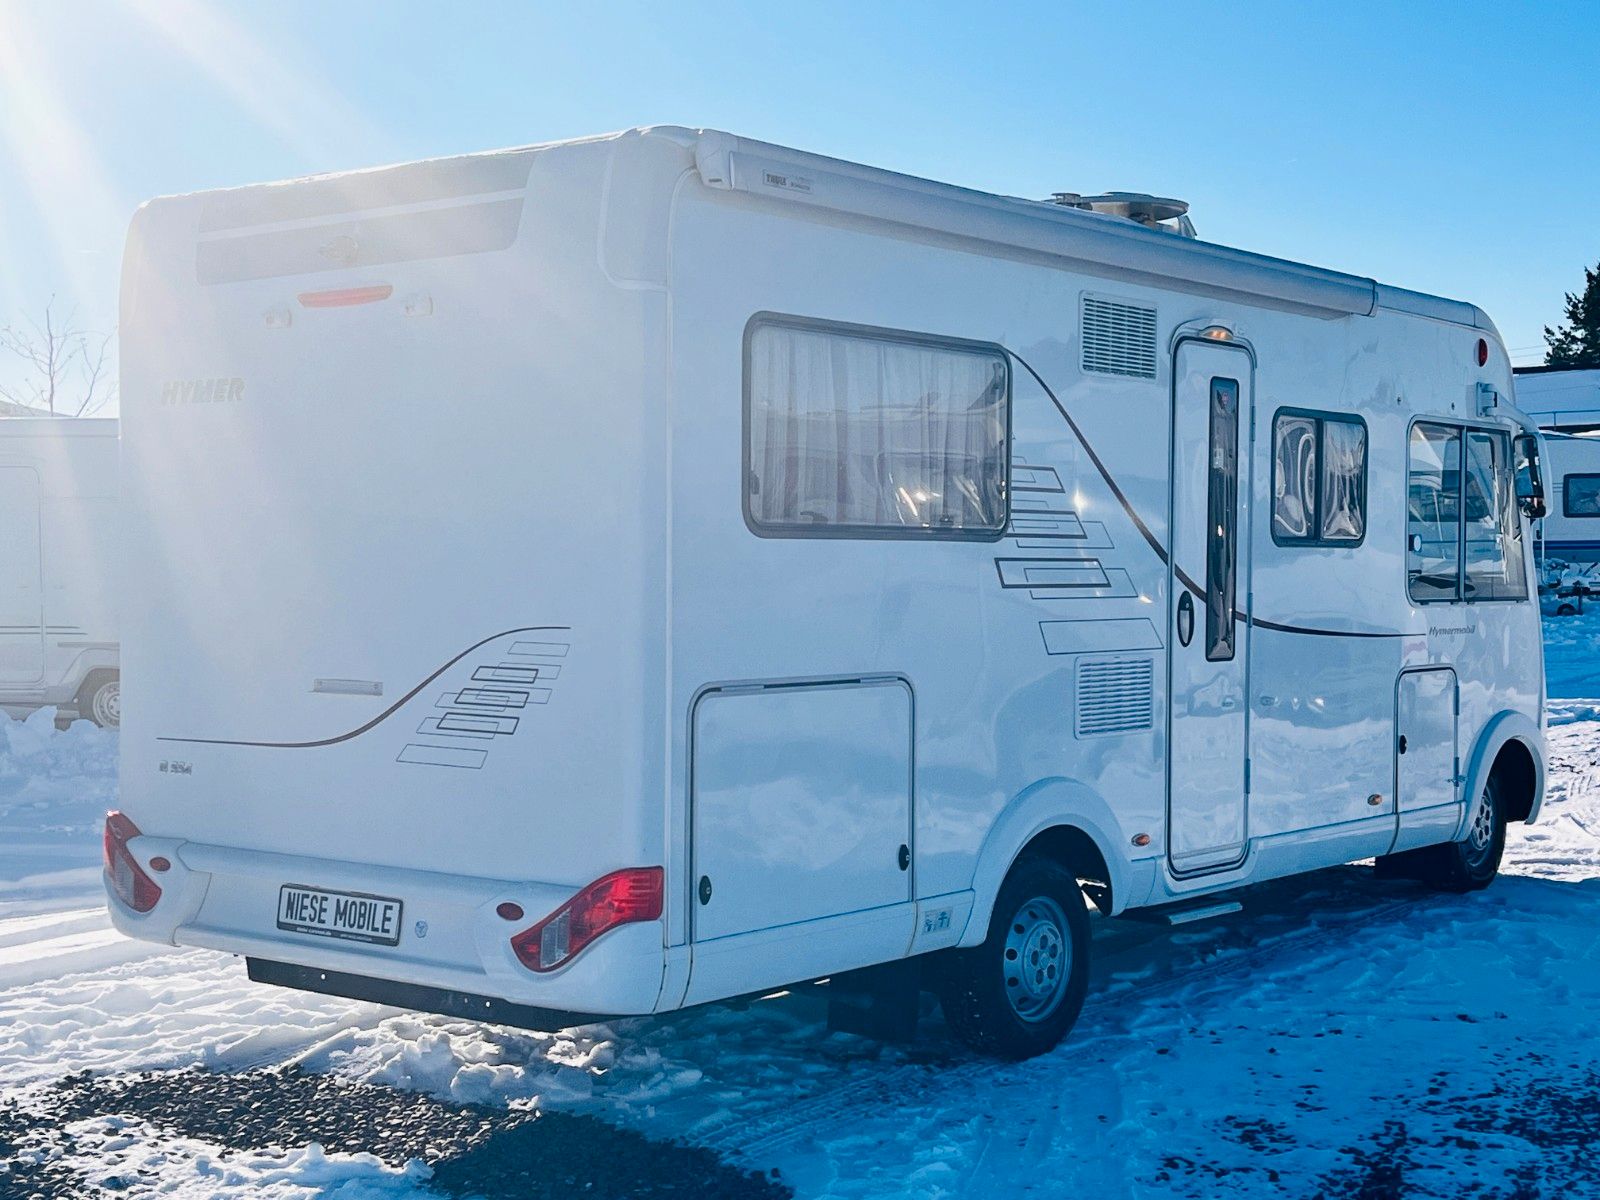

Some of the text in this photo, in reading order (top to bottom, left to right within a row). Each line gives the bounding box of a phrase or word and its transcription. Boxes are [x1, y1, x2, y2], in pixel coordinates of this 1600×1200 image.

[162, 378, 246, 405] HYMER
[1429, 625, 1476, 638] Hymermobil
[285, 891, 393, 933] NIESE MOBILE
